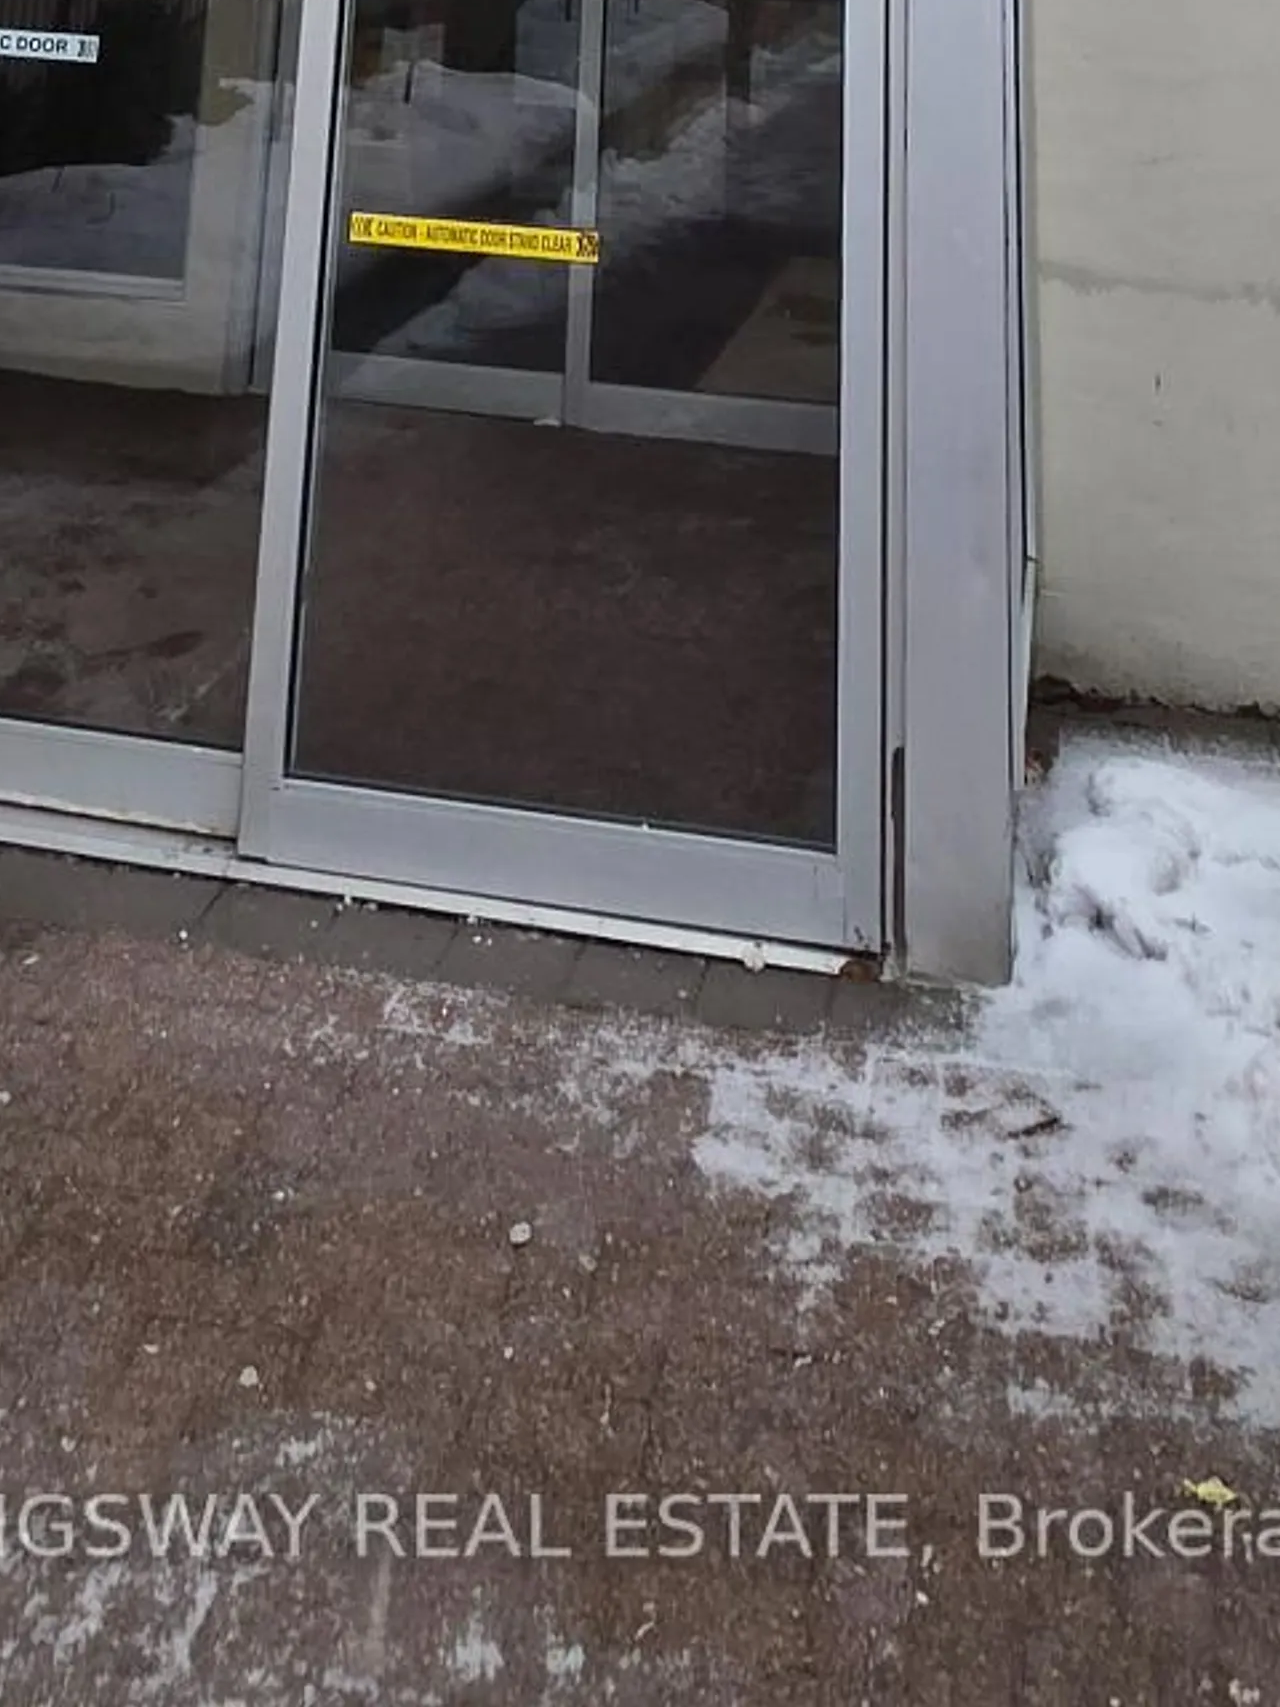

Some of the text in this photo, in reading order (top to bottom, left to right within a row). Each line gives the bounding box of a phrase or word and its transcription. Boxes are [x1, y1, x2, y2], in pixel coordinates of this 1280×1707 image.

[16, 37, 68, 54] DOOR
[377, 217, 417, 239] CAUTION
[425, 223, 478, 246] AUTOMATIC
